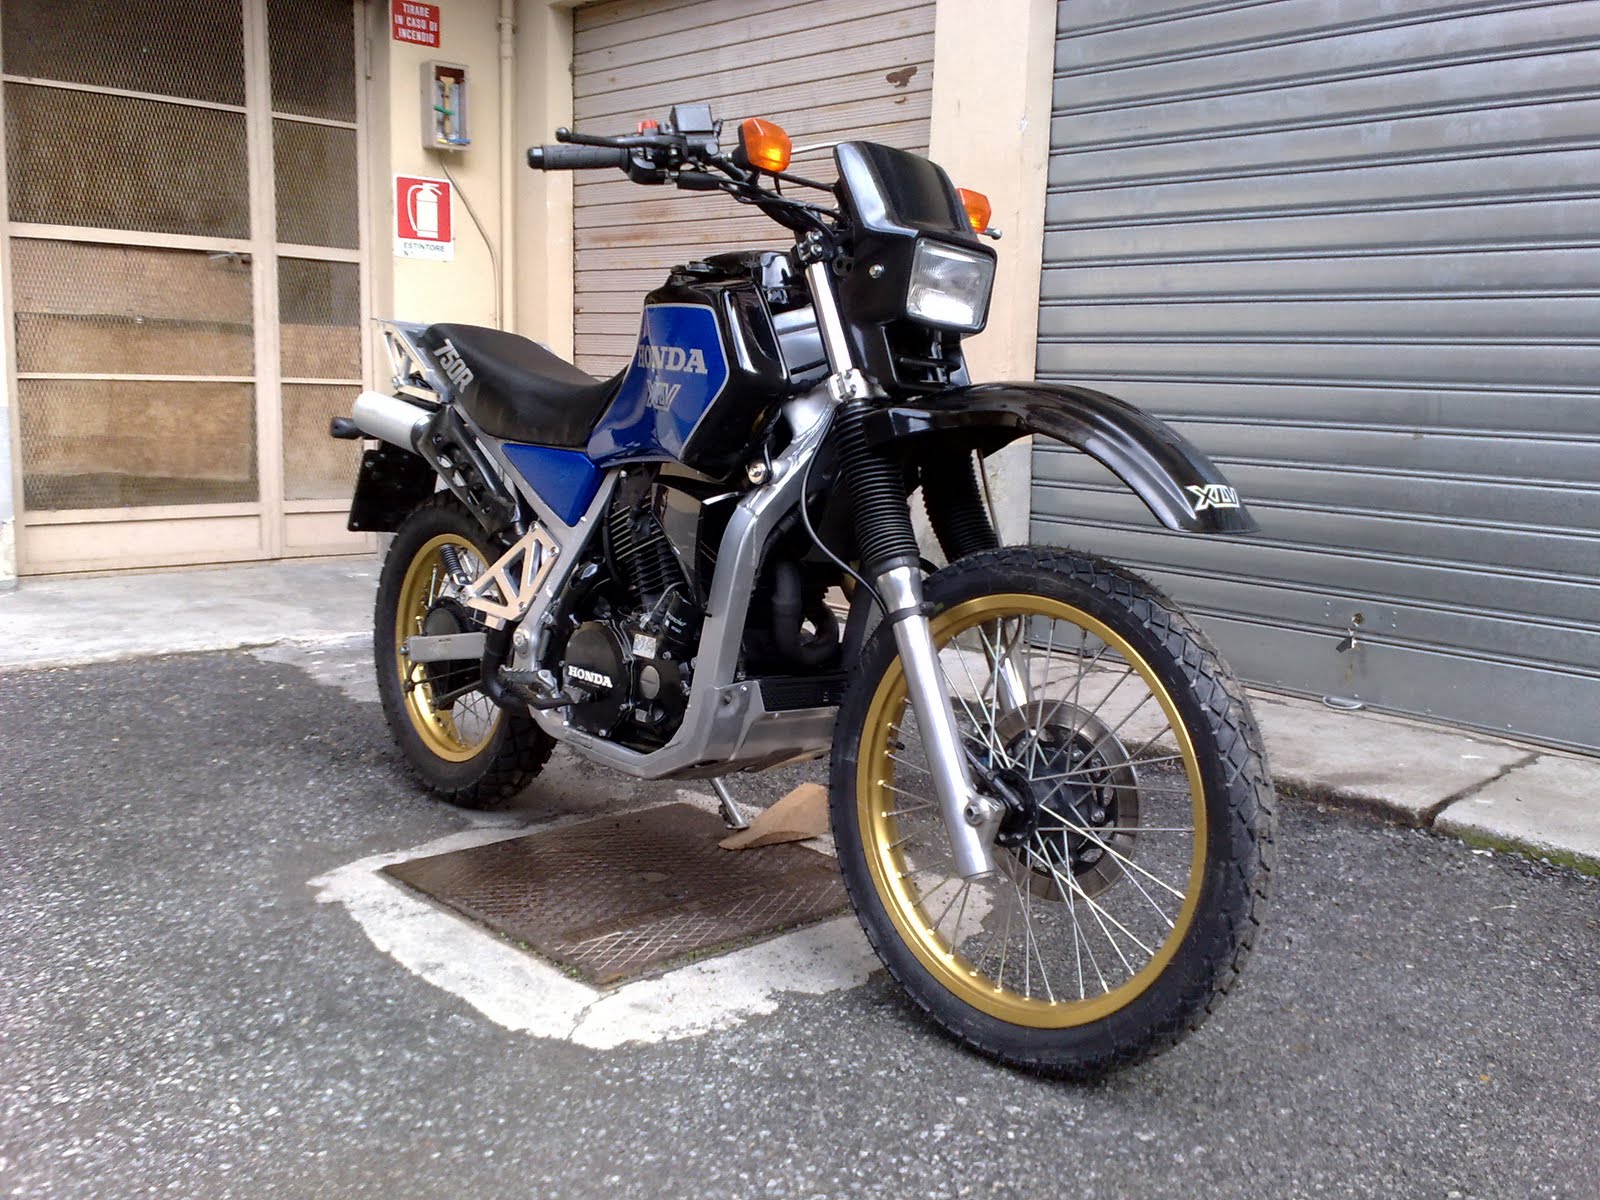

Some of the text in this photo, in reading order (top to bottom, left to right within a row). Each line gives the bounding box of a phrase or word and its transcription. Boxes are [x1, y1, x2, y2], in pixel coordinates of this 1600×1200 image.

[402, 2, 430, 18] TIRARE
[394, 14, 438, 32] IN CASO DI
[398, 27, 435, 44] INCENDIO
[403, 242, 445, 252] ESTINTORE
[433, 338, 474, 393] 750R
[637, 344, 708, 375] HONDA
[568, 665, 613, 688] HONDA
